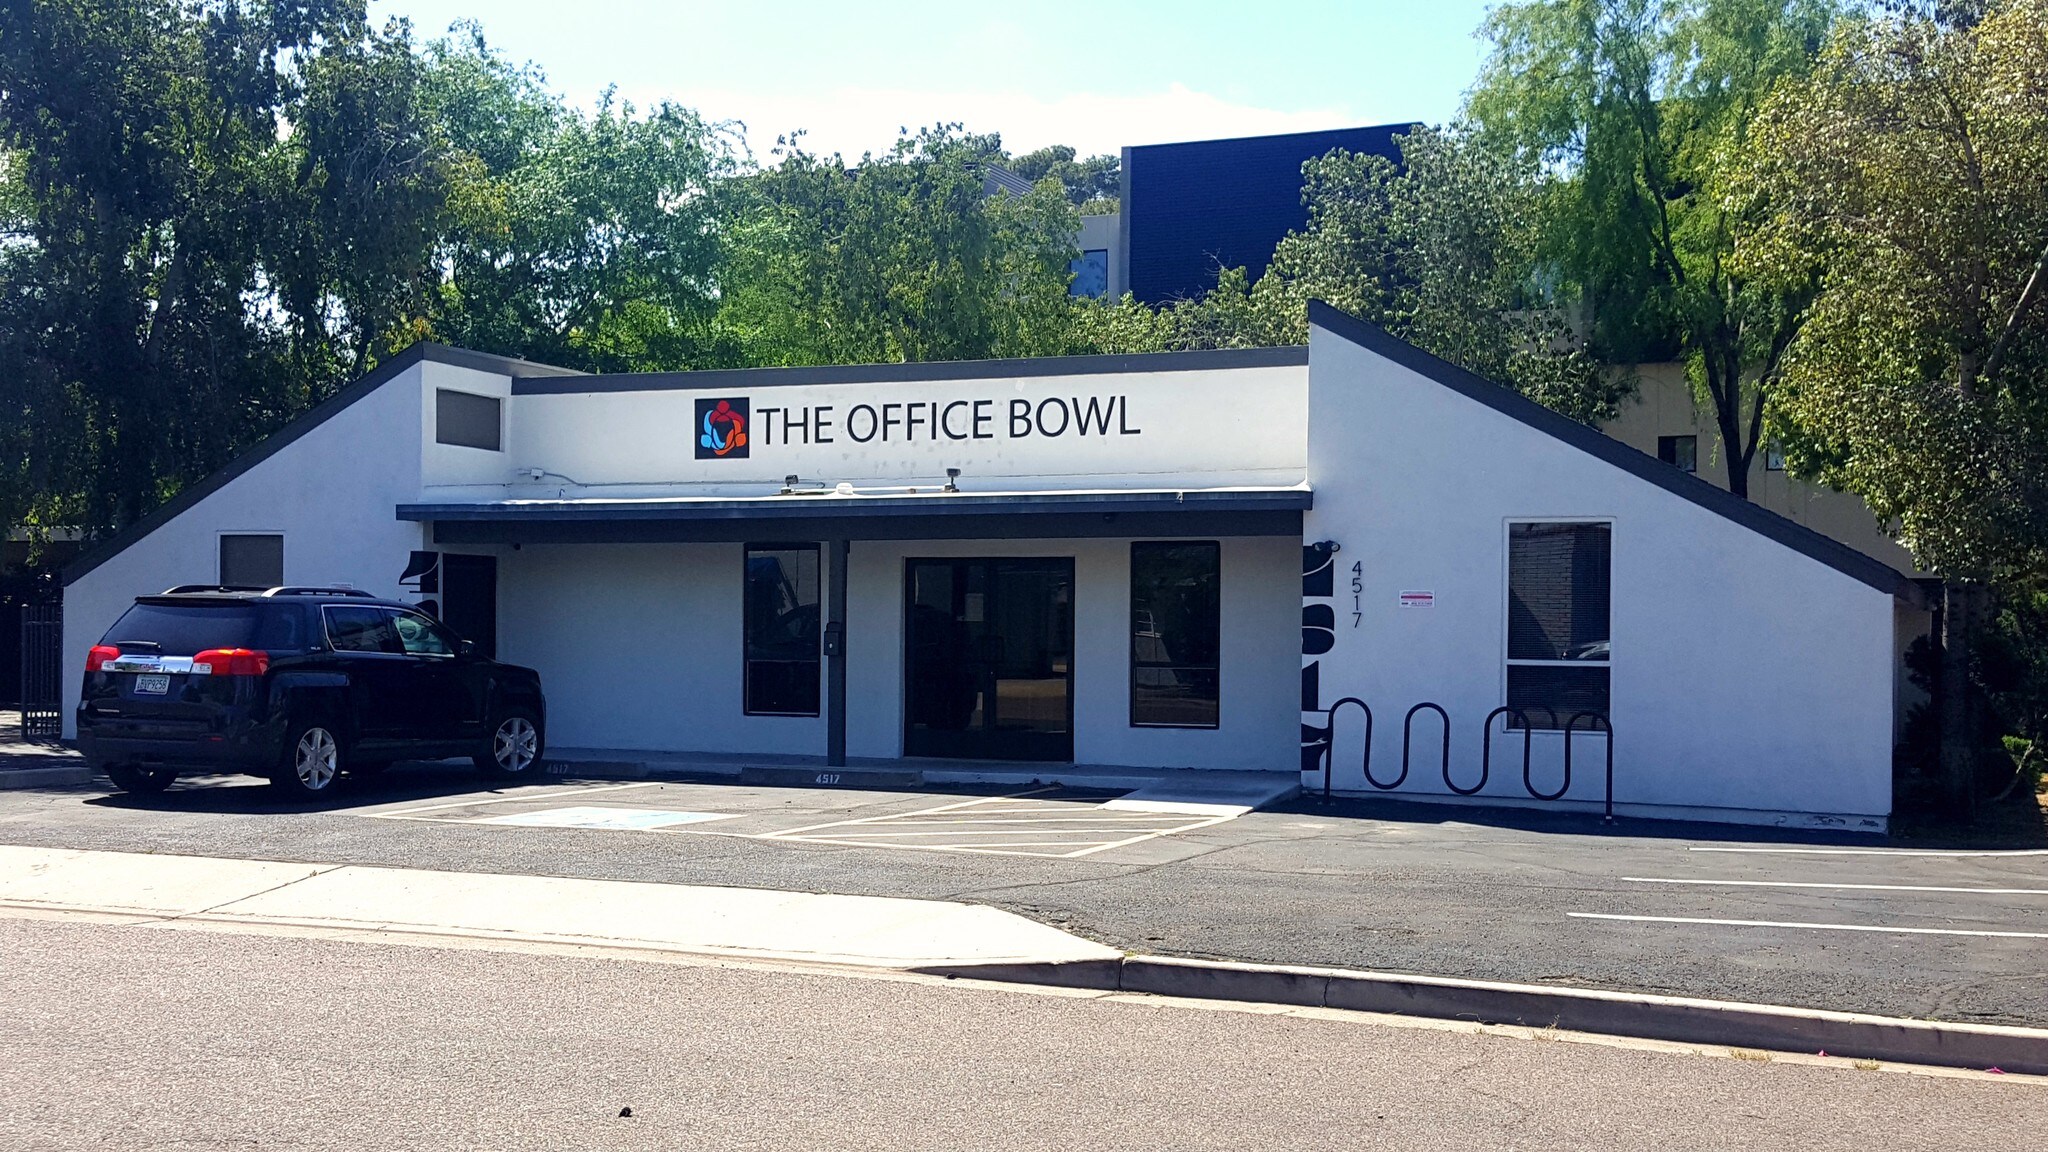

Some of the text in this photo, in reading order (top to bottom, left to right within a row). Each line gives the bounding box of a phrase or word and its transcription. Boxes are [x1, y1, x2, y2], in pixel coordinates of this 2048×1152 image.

[756, 395, 1141, 445] THE OFFICE BOWL
[1351, 560, 1363, 628] 4517
[815, 774, 840, 784] 4517
